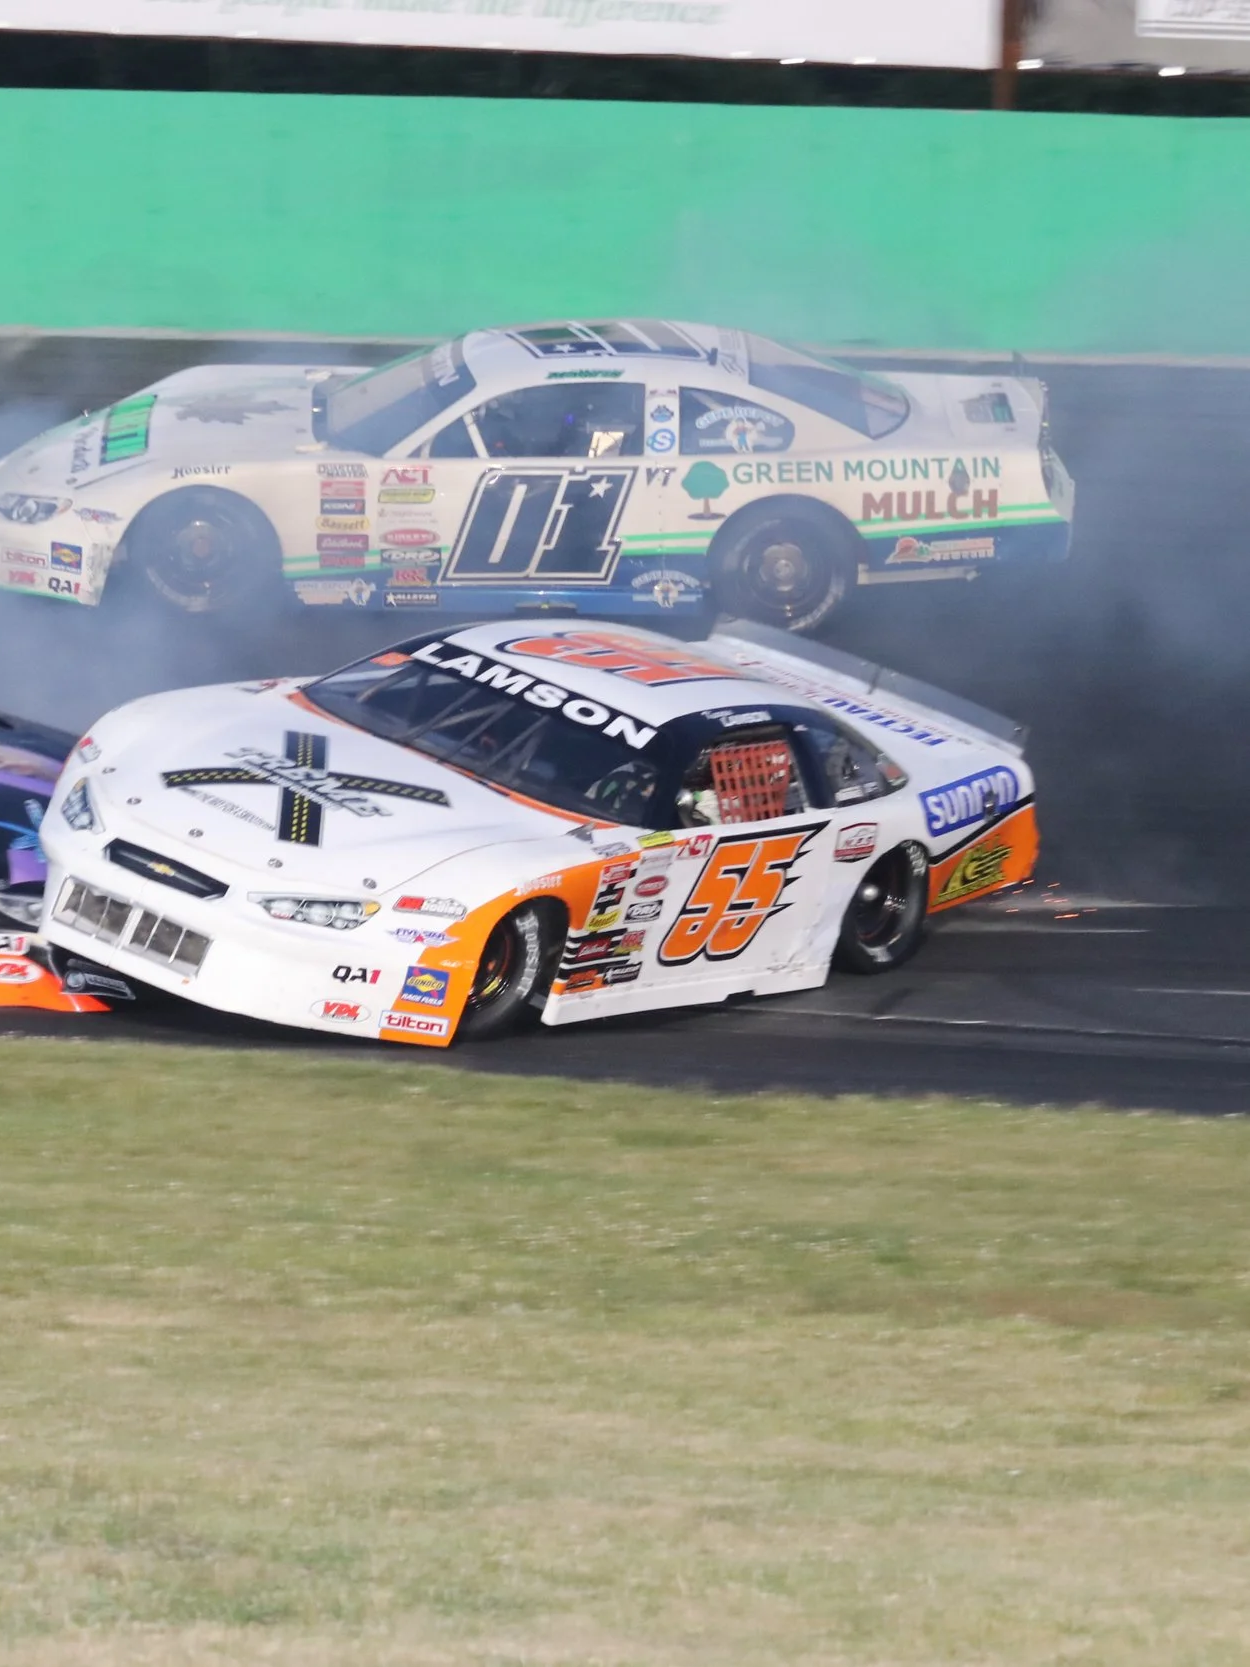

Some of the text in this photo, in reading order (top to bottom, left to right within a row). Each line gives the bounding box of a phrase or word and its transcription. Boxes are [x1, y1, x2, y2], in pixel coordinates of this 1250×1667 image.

[171, 464, 231, 479] Hoosier
[380, 465, 434, 485] ACT
[645, 467, 676, 486] VT
[732, 457, 1002, 485] GREEN MOUNTAIN
[862, 488, 999, 521] MULCH
[48, 577, 81, 594] QA1
[409, 642, 658, 750] LAMSON
[658, 822, 820, 966] 55
[332, 965, 381, 984] QA1
[408, 976, 445, 989] SUNOCO
[401, 993, 422, 1002] RACE
[385, 1013, 444, 1033] tilton
